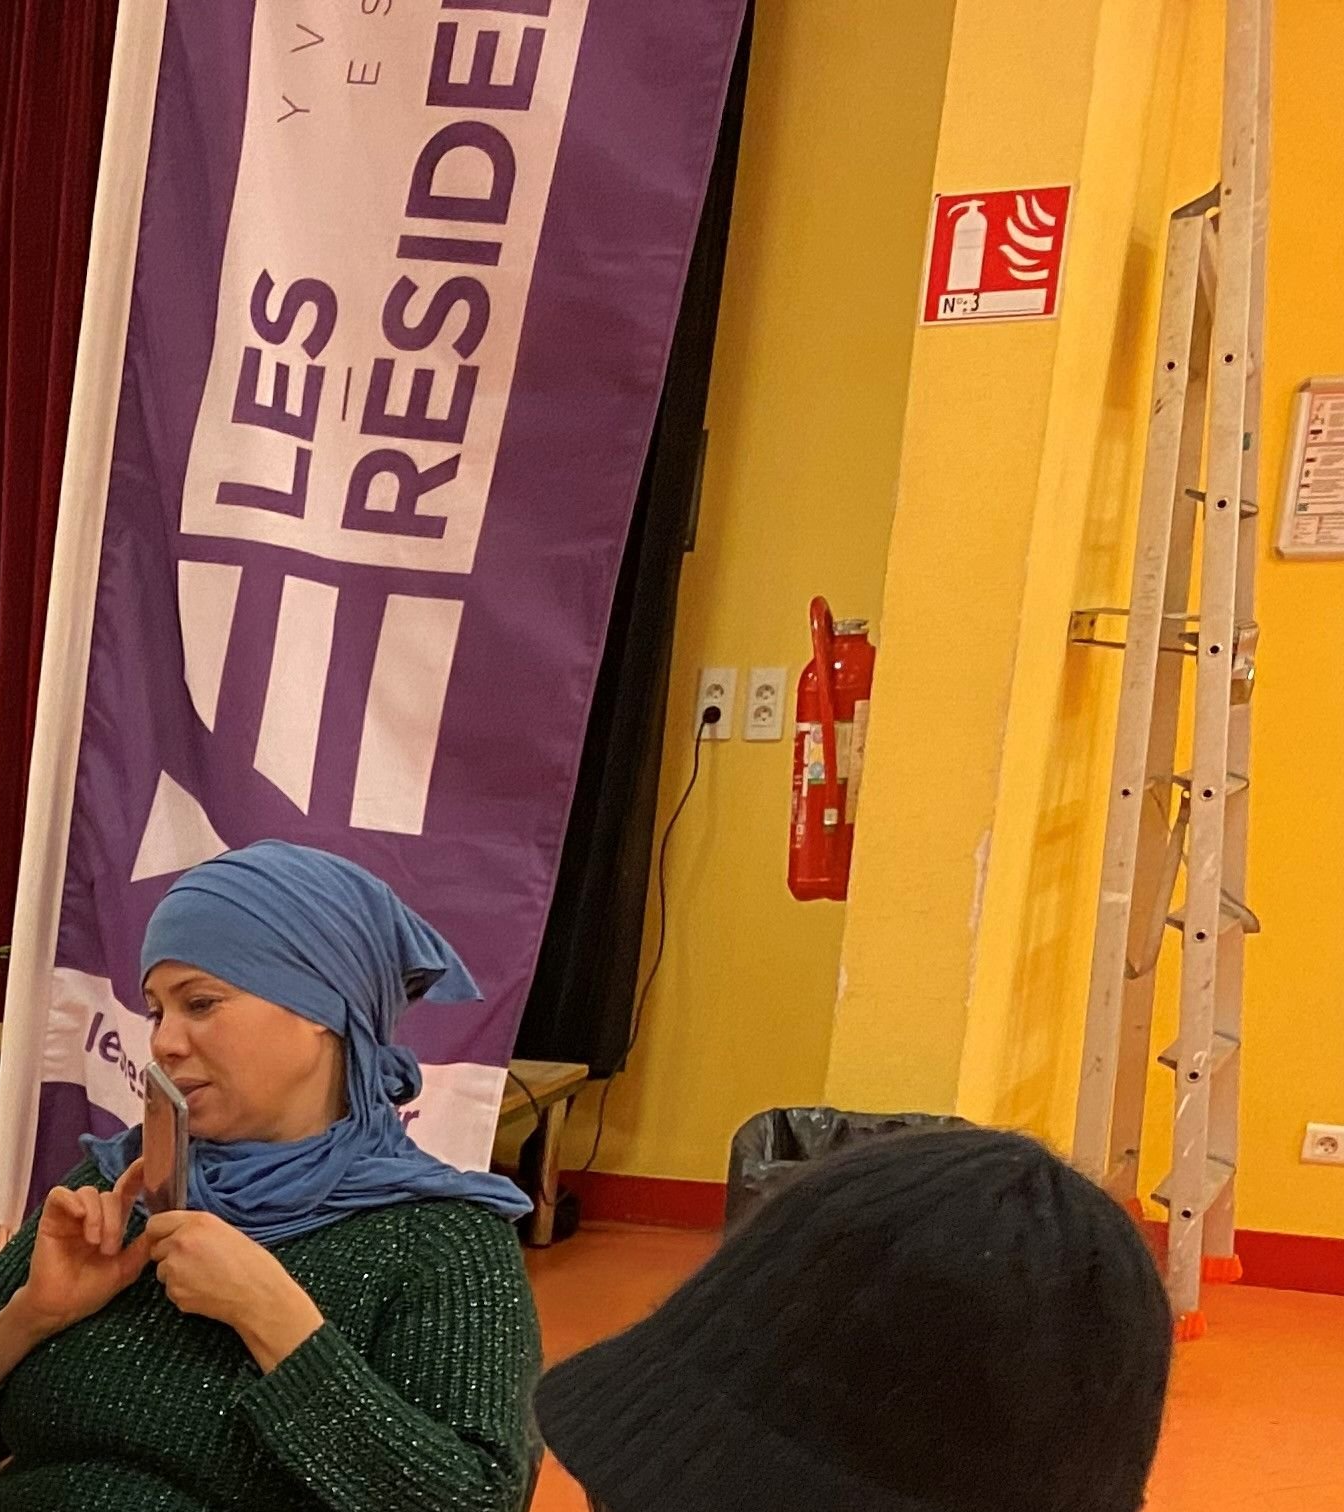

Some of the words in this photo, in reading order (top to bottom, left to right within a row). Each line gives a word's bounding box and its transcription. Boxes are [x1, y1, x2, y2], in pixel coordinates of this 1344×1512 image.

[277, 23, 324, 123] YV
[215, 267, 338, 520] LES
[340, 0, 551, 540] RESIDE
